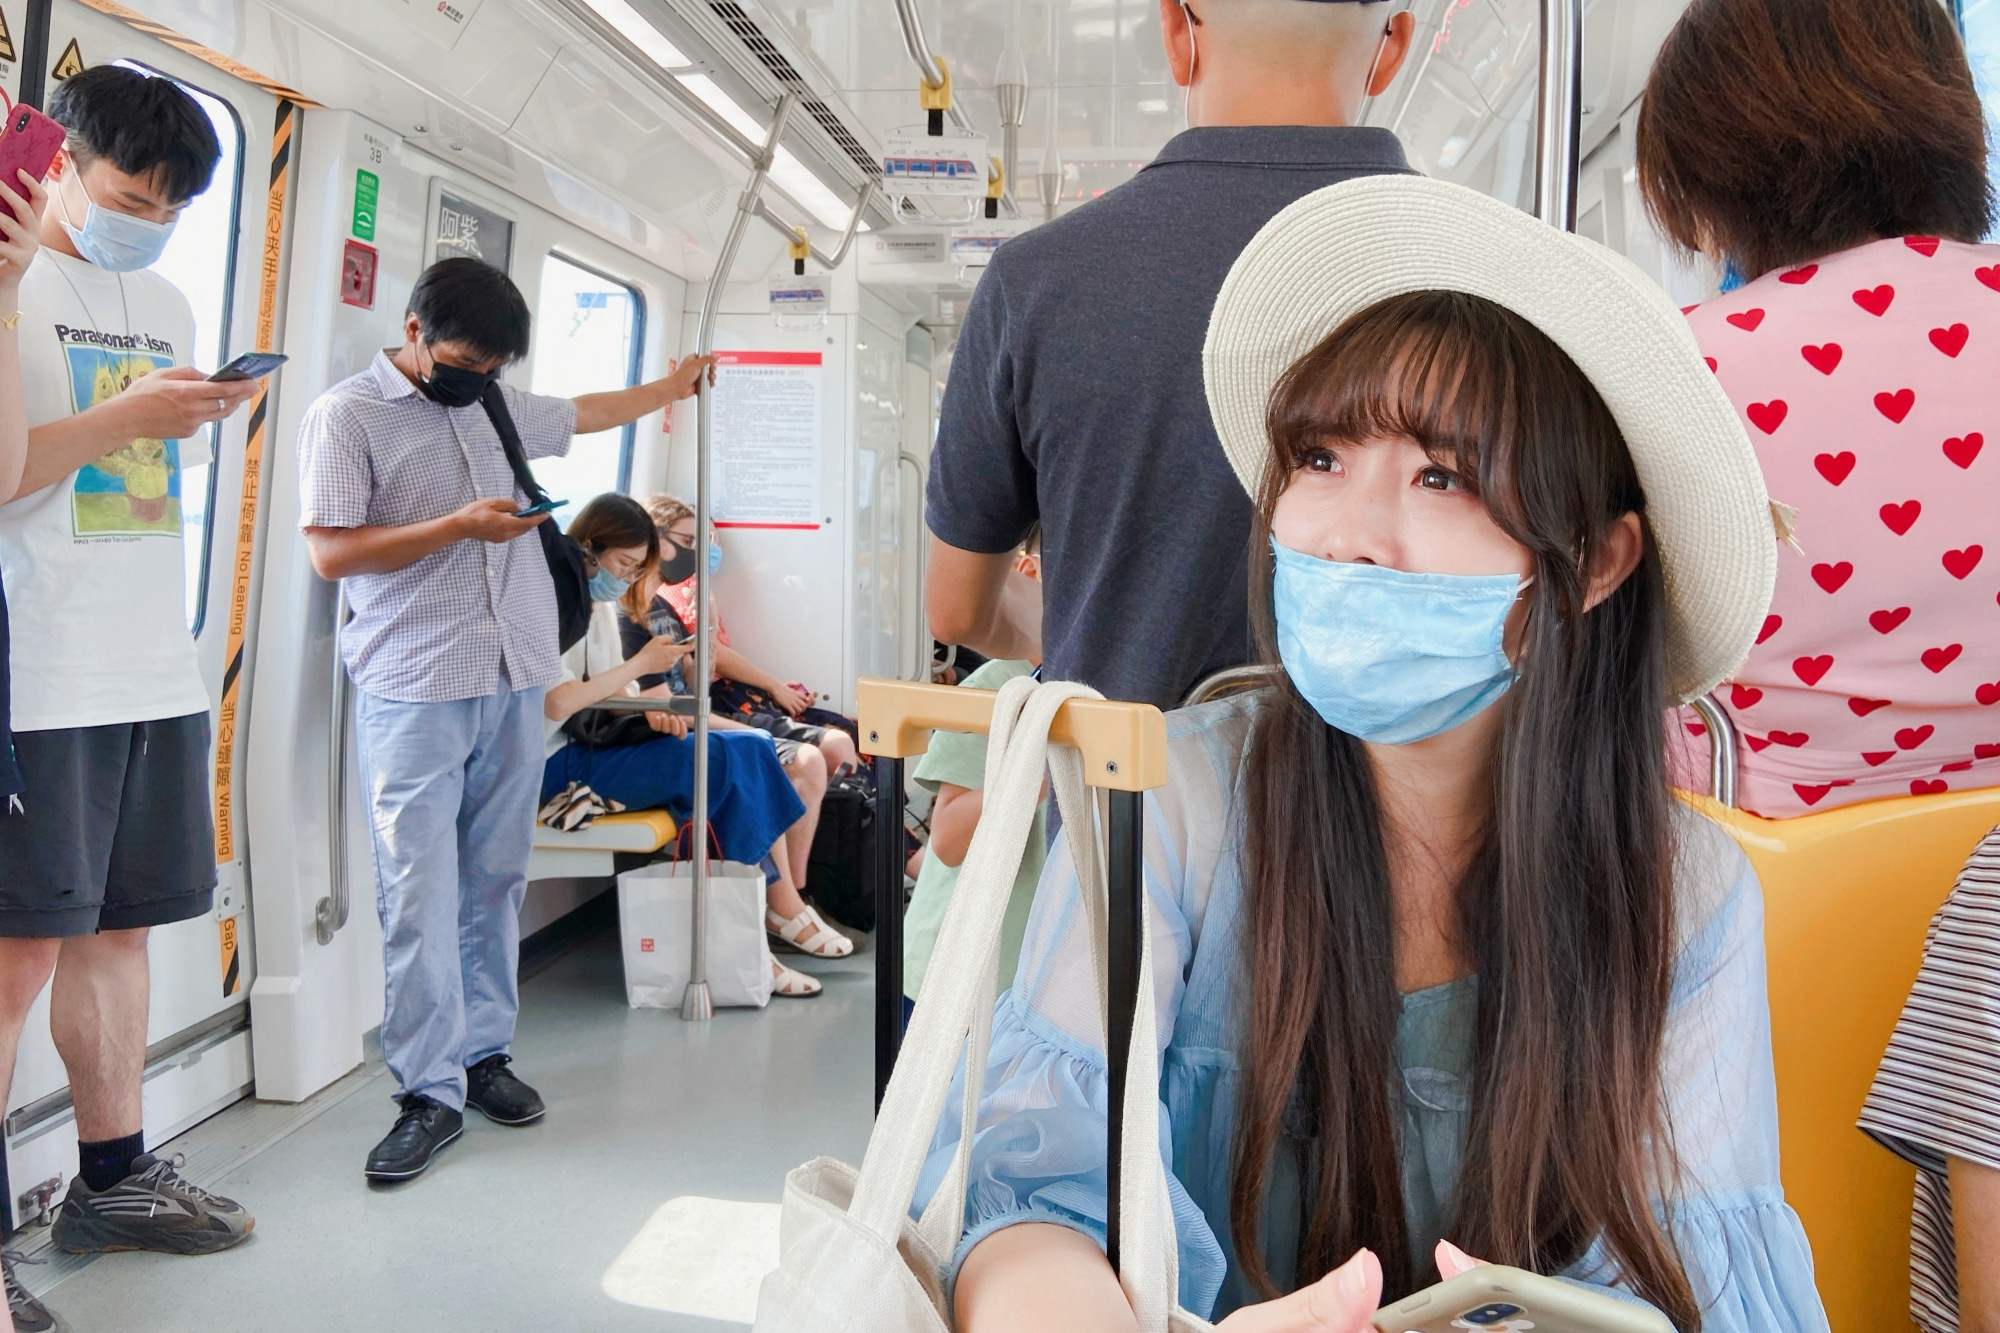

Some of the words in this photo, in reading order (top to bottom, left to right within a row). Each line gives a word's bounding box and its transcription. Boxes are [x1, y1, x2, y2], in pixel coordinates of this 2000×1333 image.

[369, 147, 382, 164] 3B
[264, 189, 283, 278] 当心夹手
[440, 206, 479, 252] 阿紫
[260, 320, 273, 350] Hands
[240, 457, 260, 544] 禁止倚靠
[240, 550, 251, 572] No
[230, 575, 249, 636] Leaning
[217, 701, 235, 788] 当心缝隙
[218, 791, 231, 856] Warning
[222, 917, 236, 950] Gap
